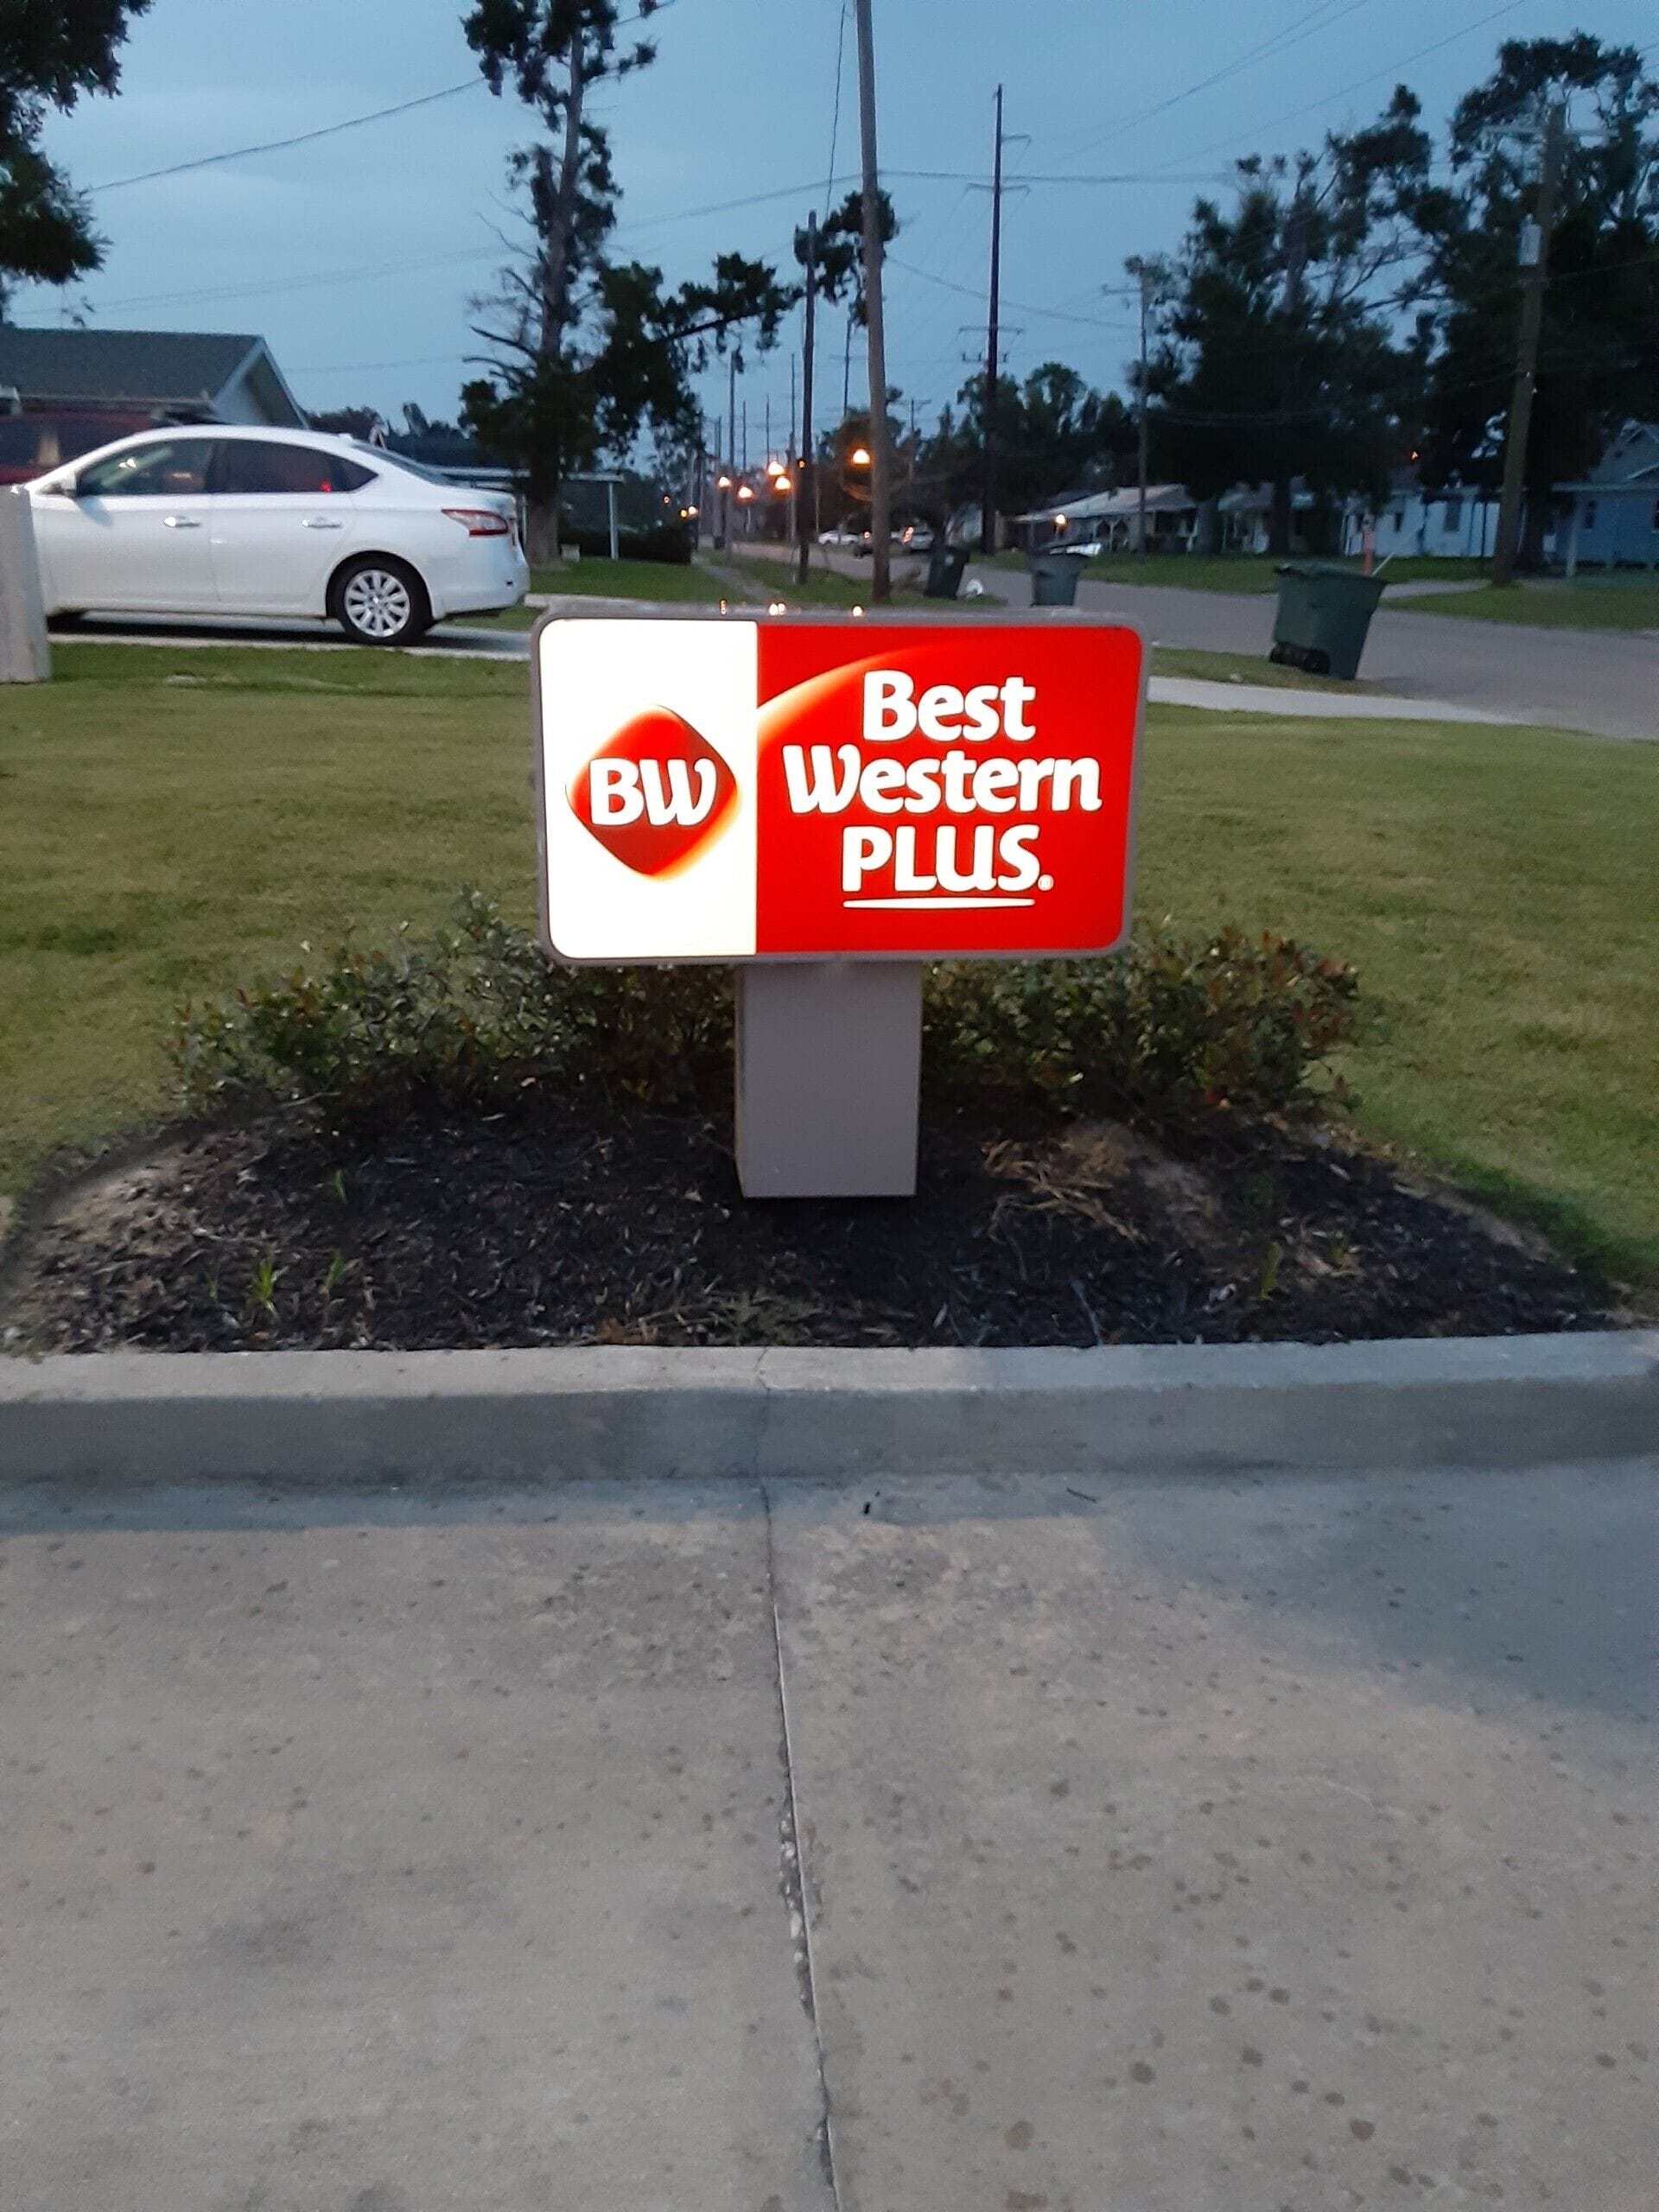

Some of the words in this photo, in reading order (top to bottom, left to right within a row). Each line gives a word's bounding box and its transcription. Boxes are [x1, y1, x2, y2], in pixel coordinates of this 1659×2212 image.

[863, 670, 1036, 742] Best
[589, 758, 716, 826] BW
[783, 744, 1103, 814] Western
